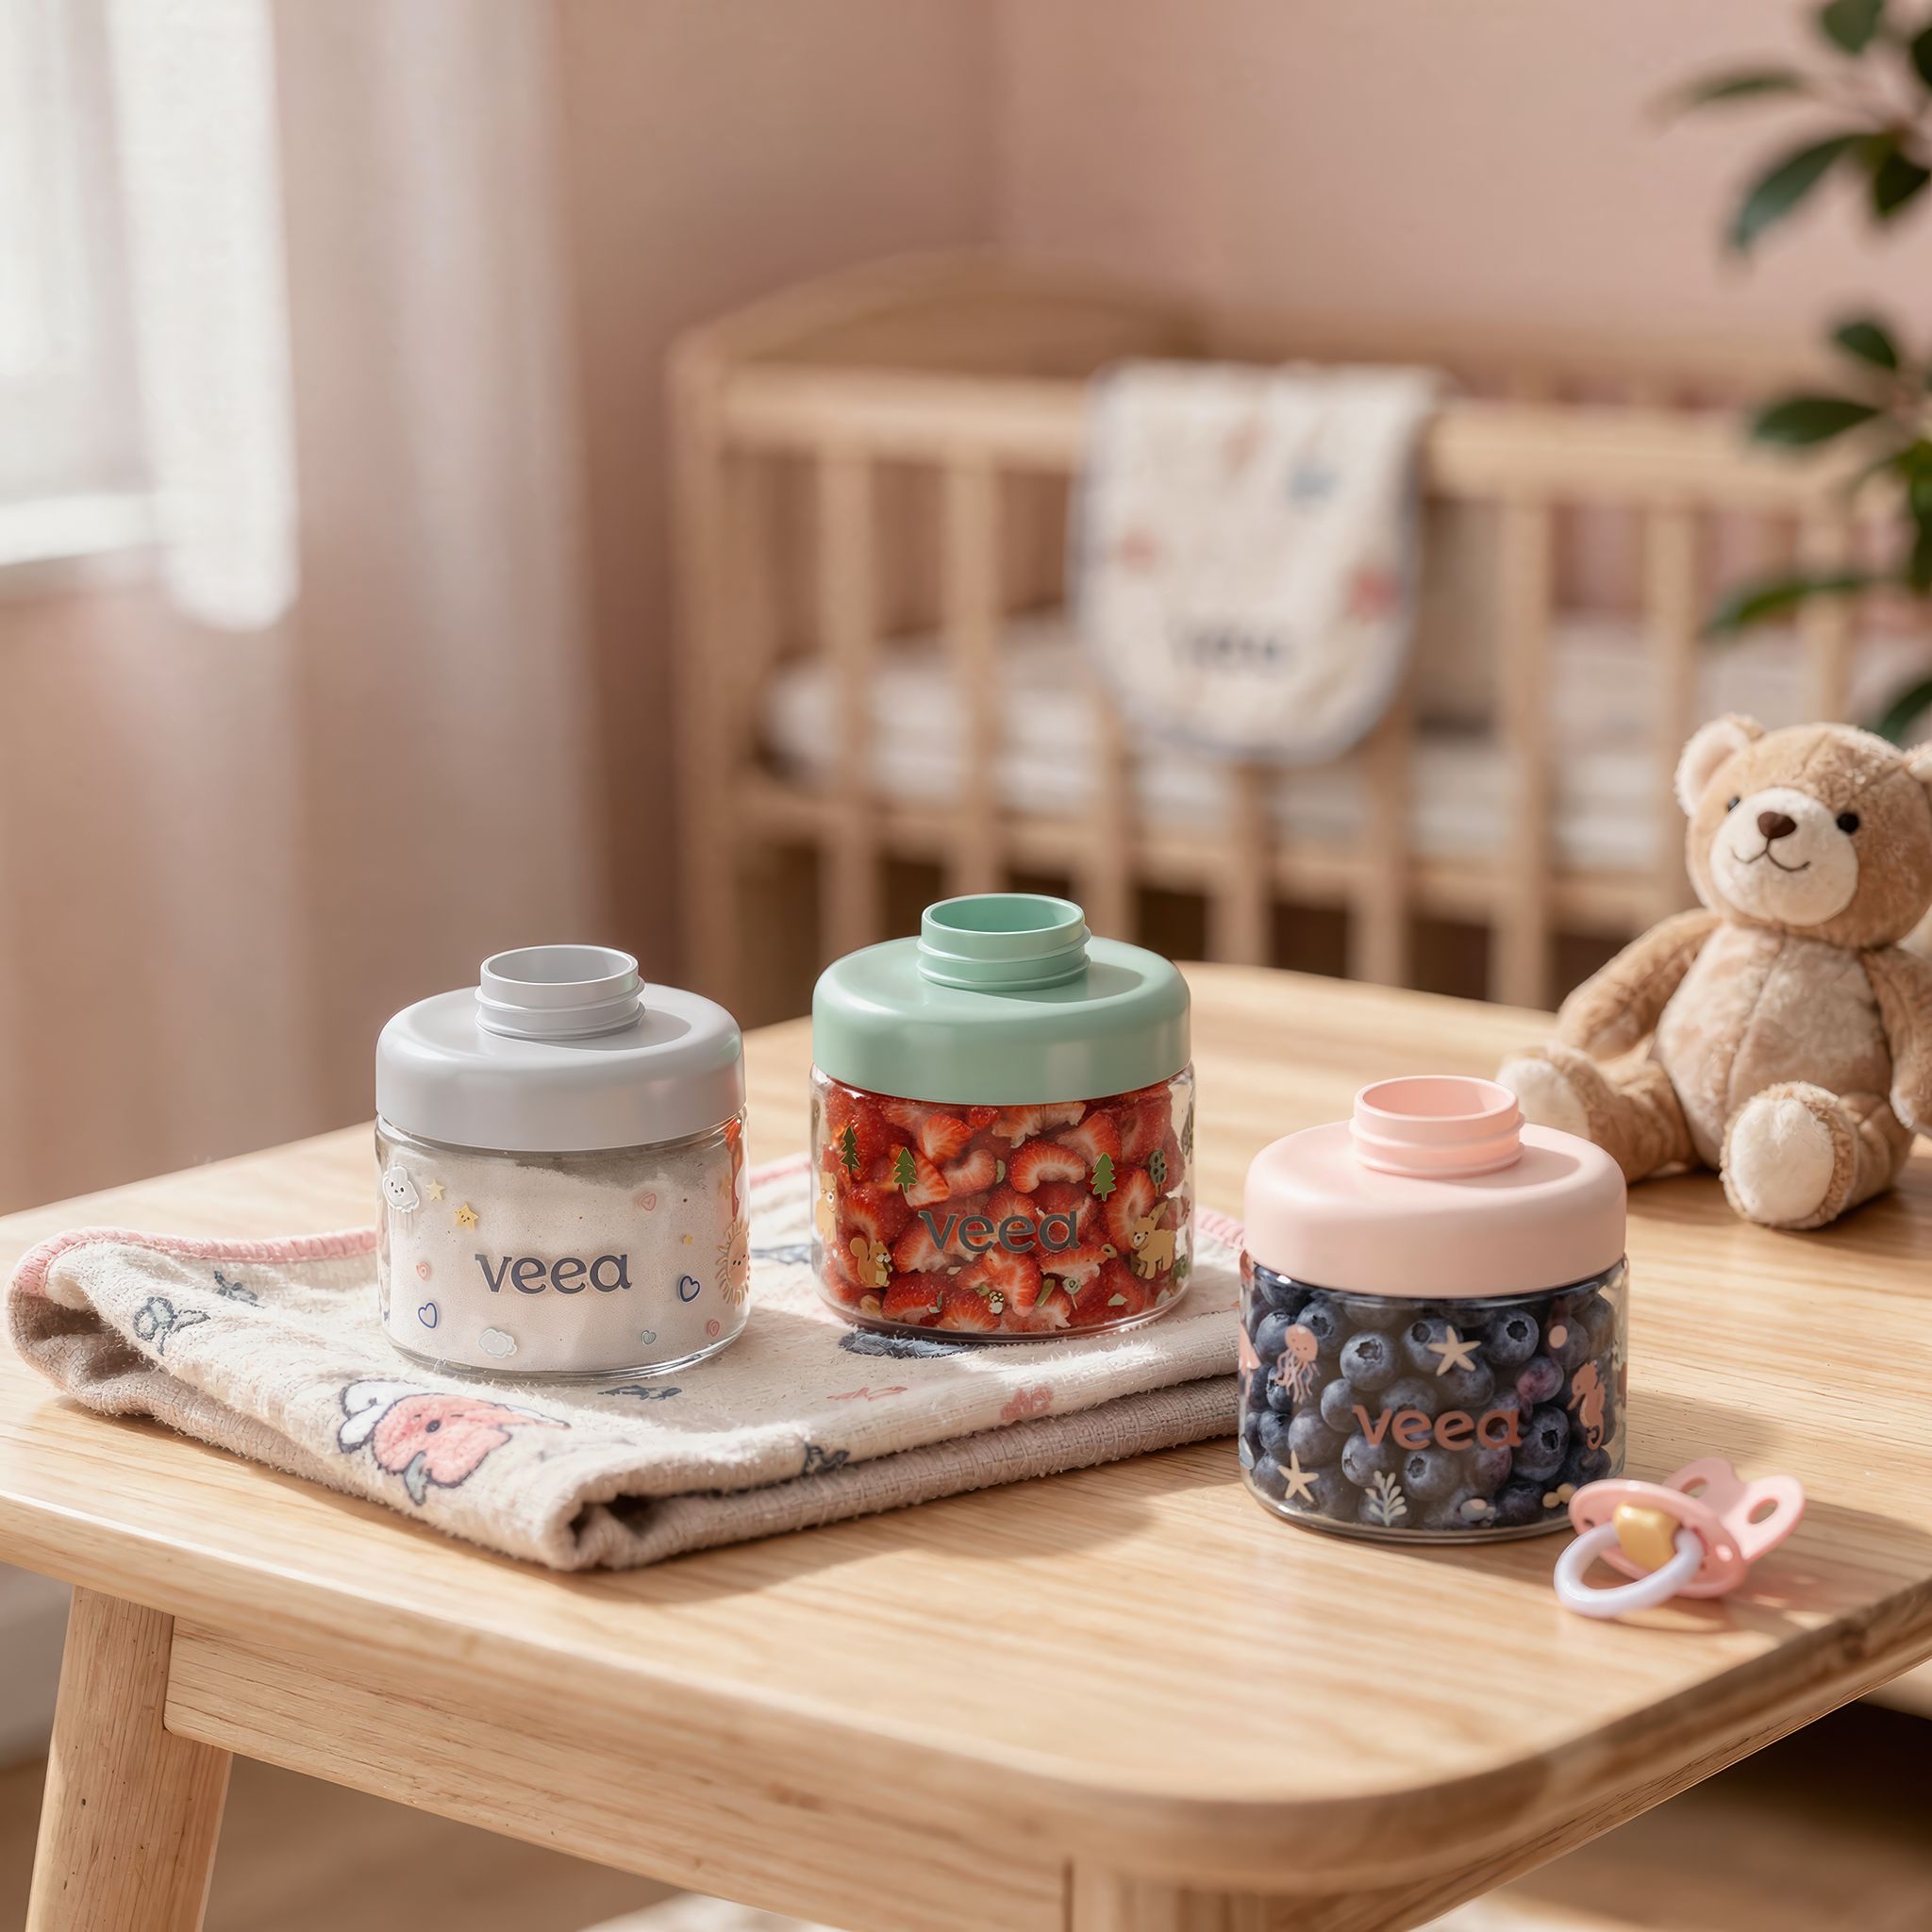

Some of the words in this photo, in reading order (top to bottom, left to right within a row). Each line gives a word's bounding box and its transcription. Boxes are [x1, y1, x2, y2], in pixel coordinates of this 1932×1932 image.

[918, 1209, 1081, 1253] veea
[475, 1254, 632, 1293] veea
[1352, 1404, 1523, 1450] veea
